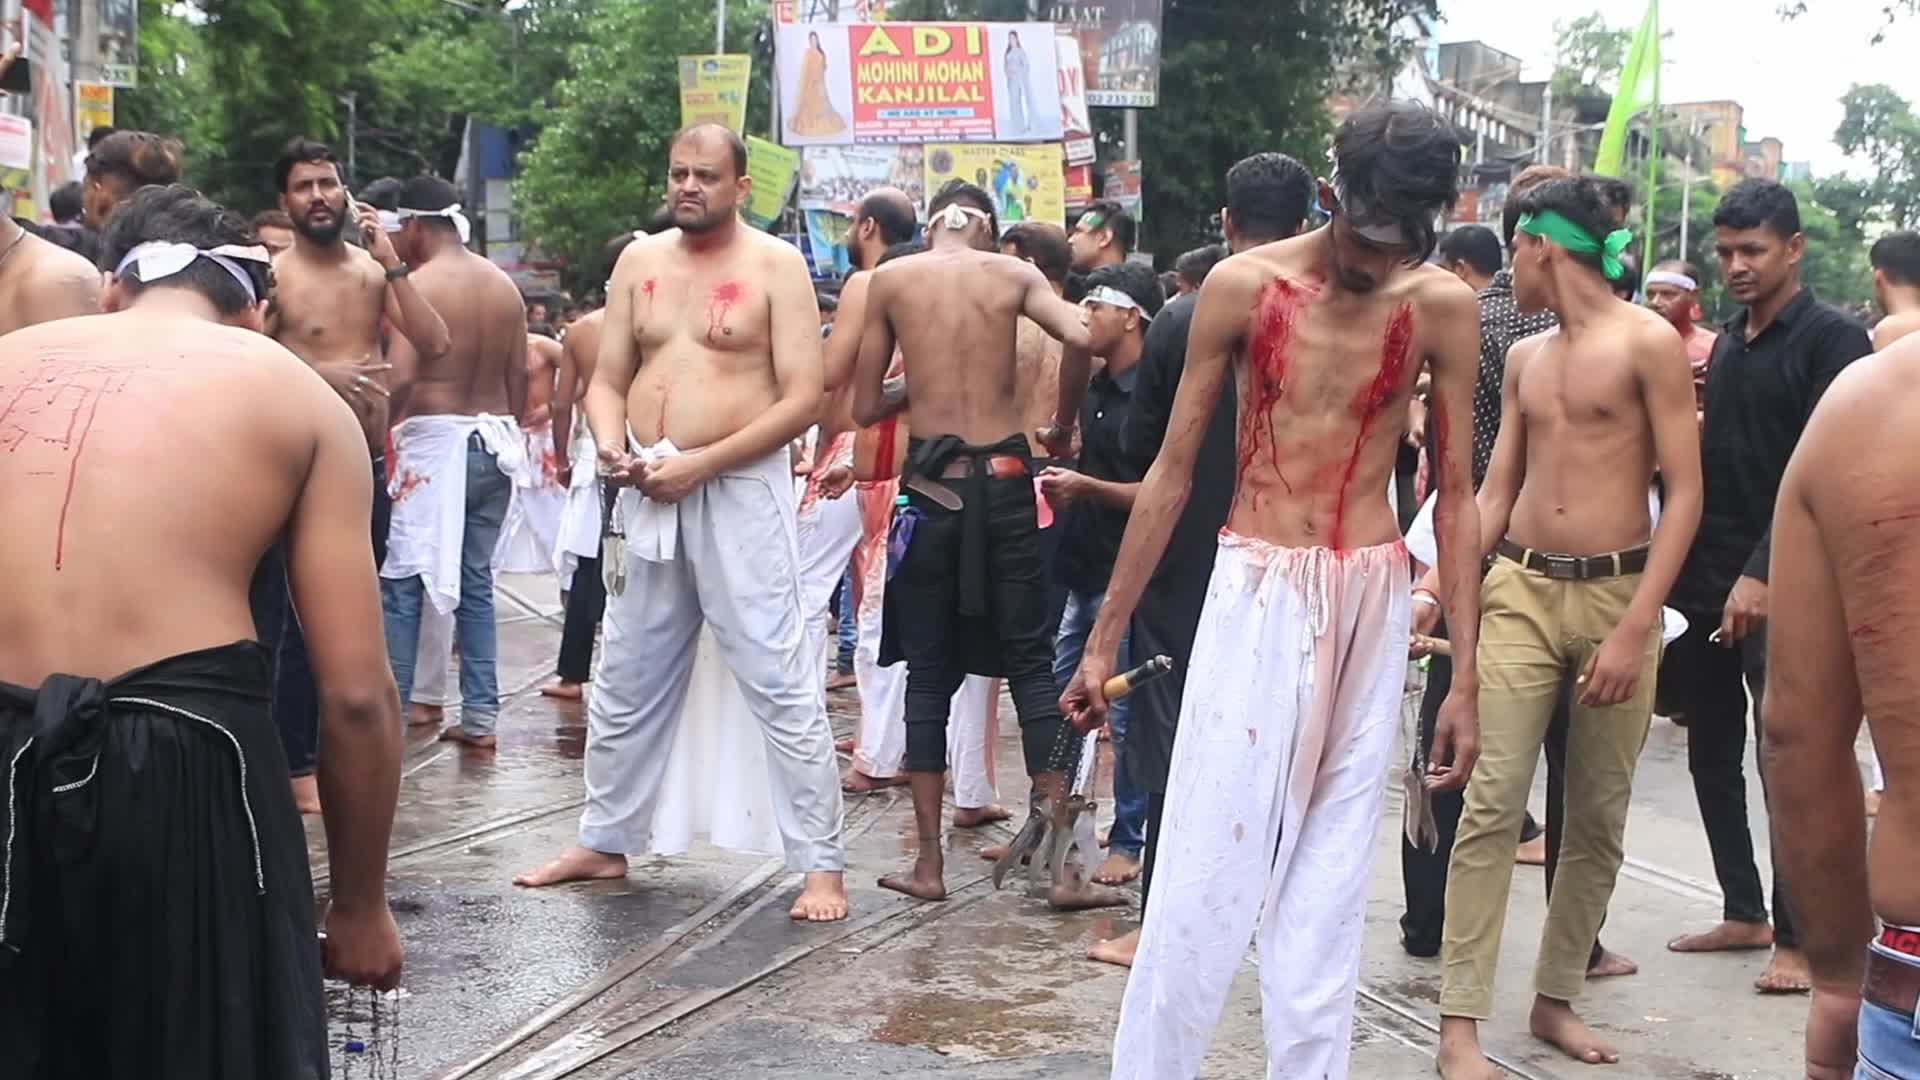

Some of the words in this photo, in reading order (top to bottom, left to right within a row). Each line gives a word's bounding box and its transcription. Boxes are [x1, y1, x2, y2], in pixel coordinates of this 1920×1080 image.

[857, 61, 919, 83] MOHINI
[923, 60, 983, 82] MOHAN
[858, 85, 985, 103] KANJILAL
